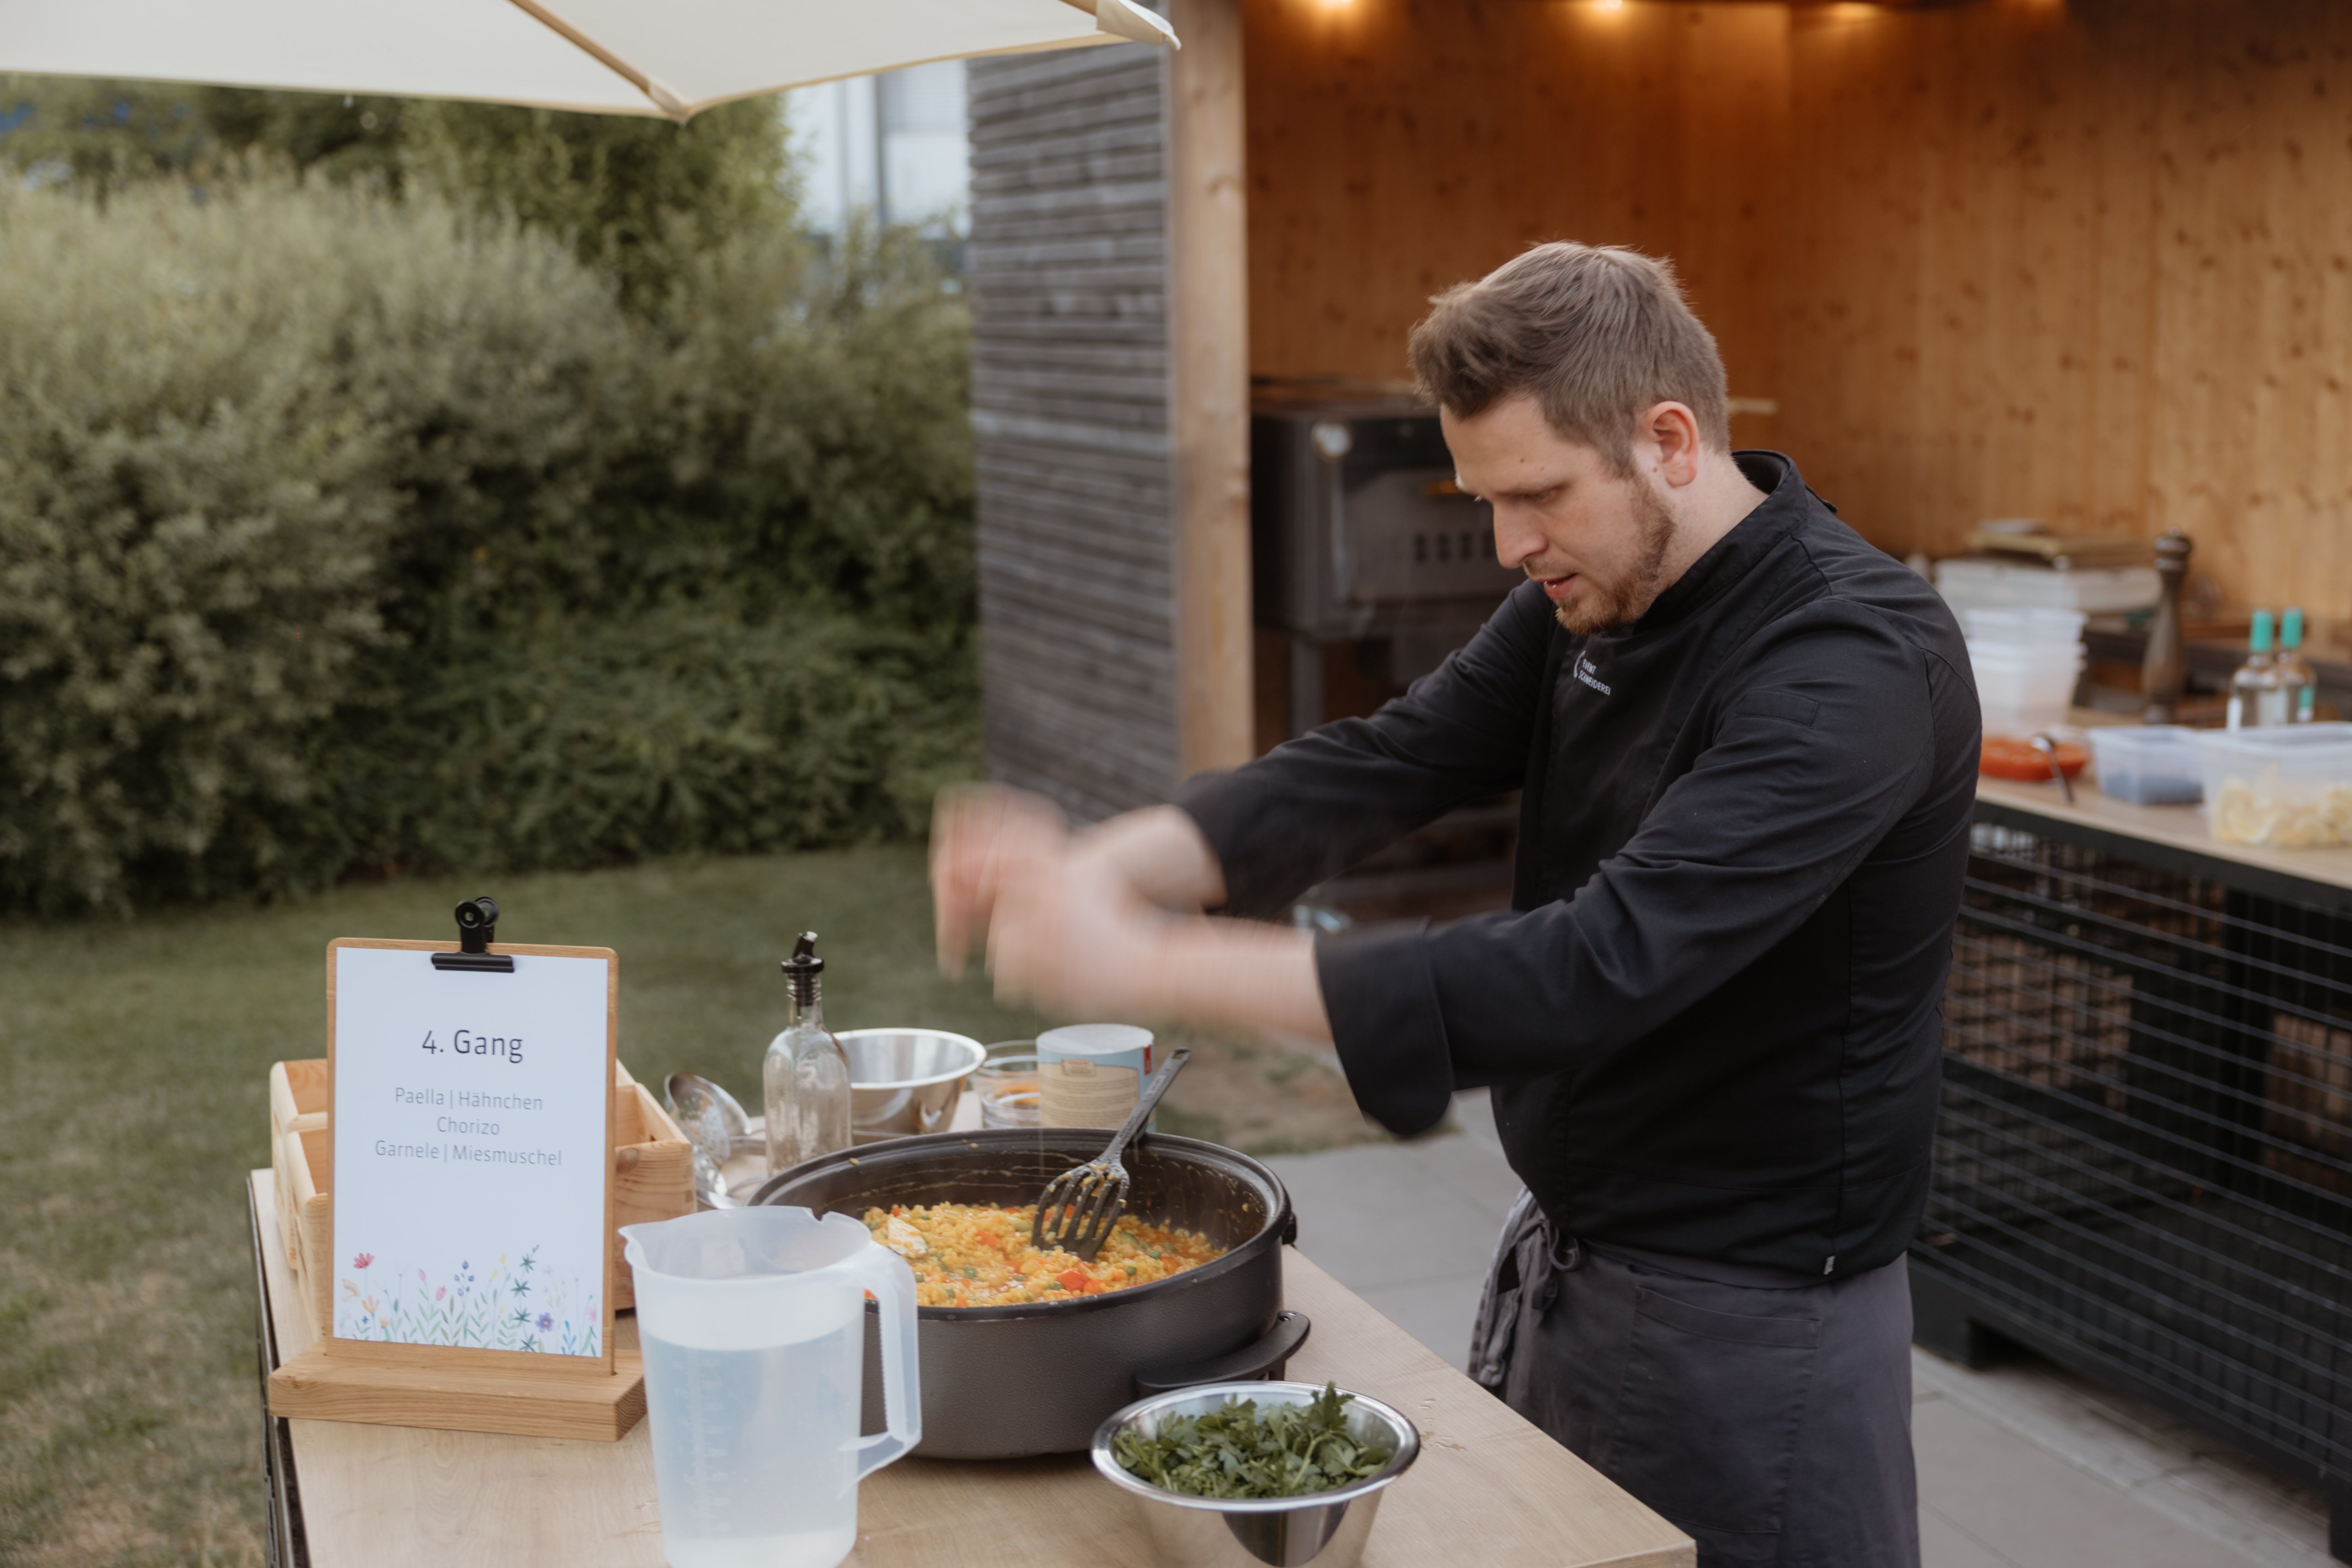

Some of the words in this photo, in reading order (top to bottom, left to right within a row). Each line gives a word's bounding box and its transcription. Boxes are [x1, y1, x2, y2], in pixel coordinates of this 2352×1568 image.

[1583, 659, 1596, 674] EVENT
[1579, 670, 1611, 695] SCHNEIDEREI
[421, 1029, 445, 1055] 4.
[453, 1029, 524, 1064] Gang
[395, 1087, 444, 1105] Paella
[459, 1090, 543, 1110] Hähnchen
[437, 1116, 501, 1136] Chorizo
[375, 1139, 440, 1159] Garnele
[452, 1144, 562, 1166] Miesmuschel
